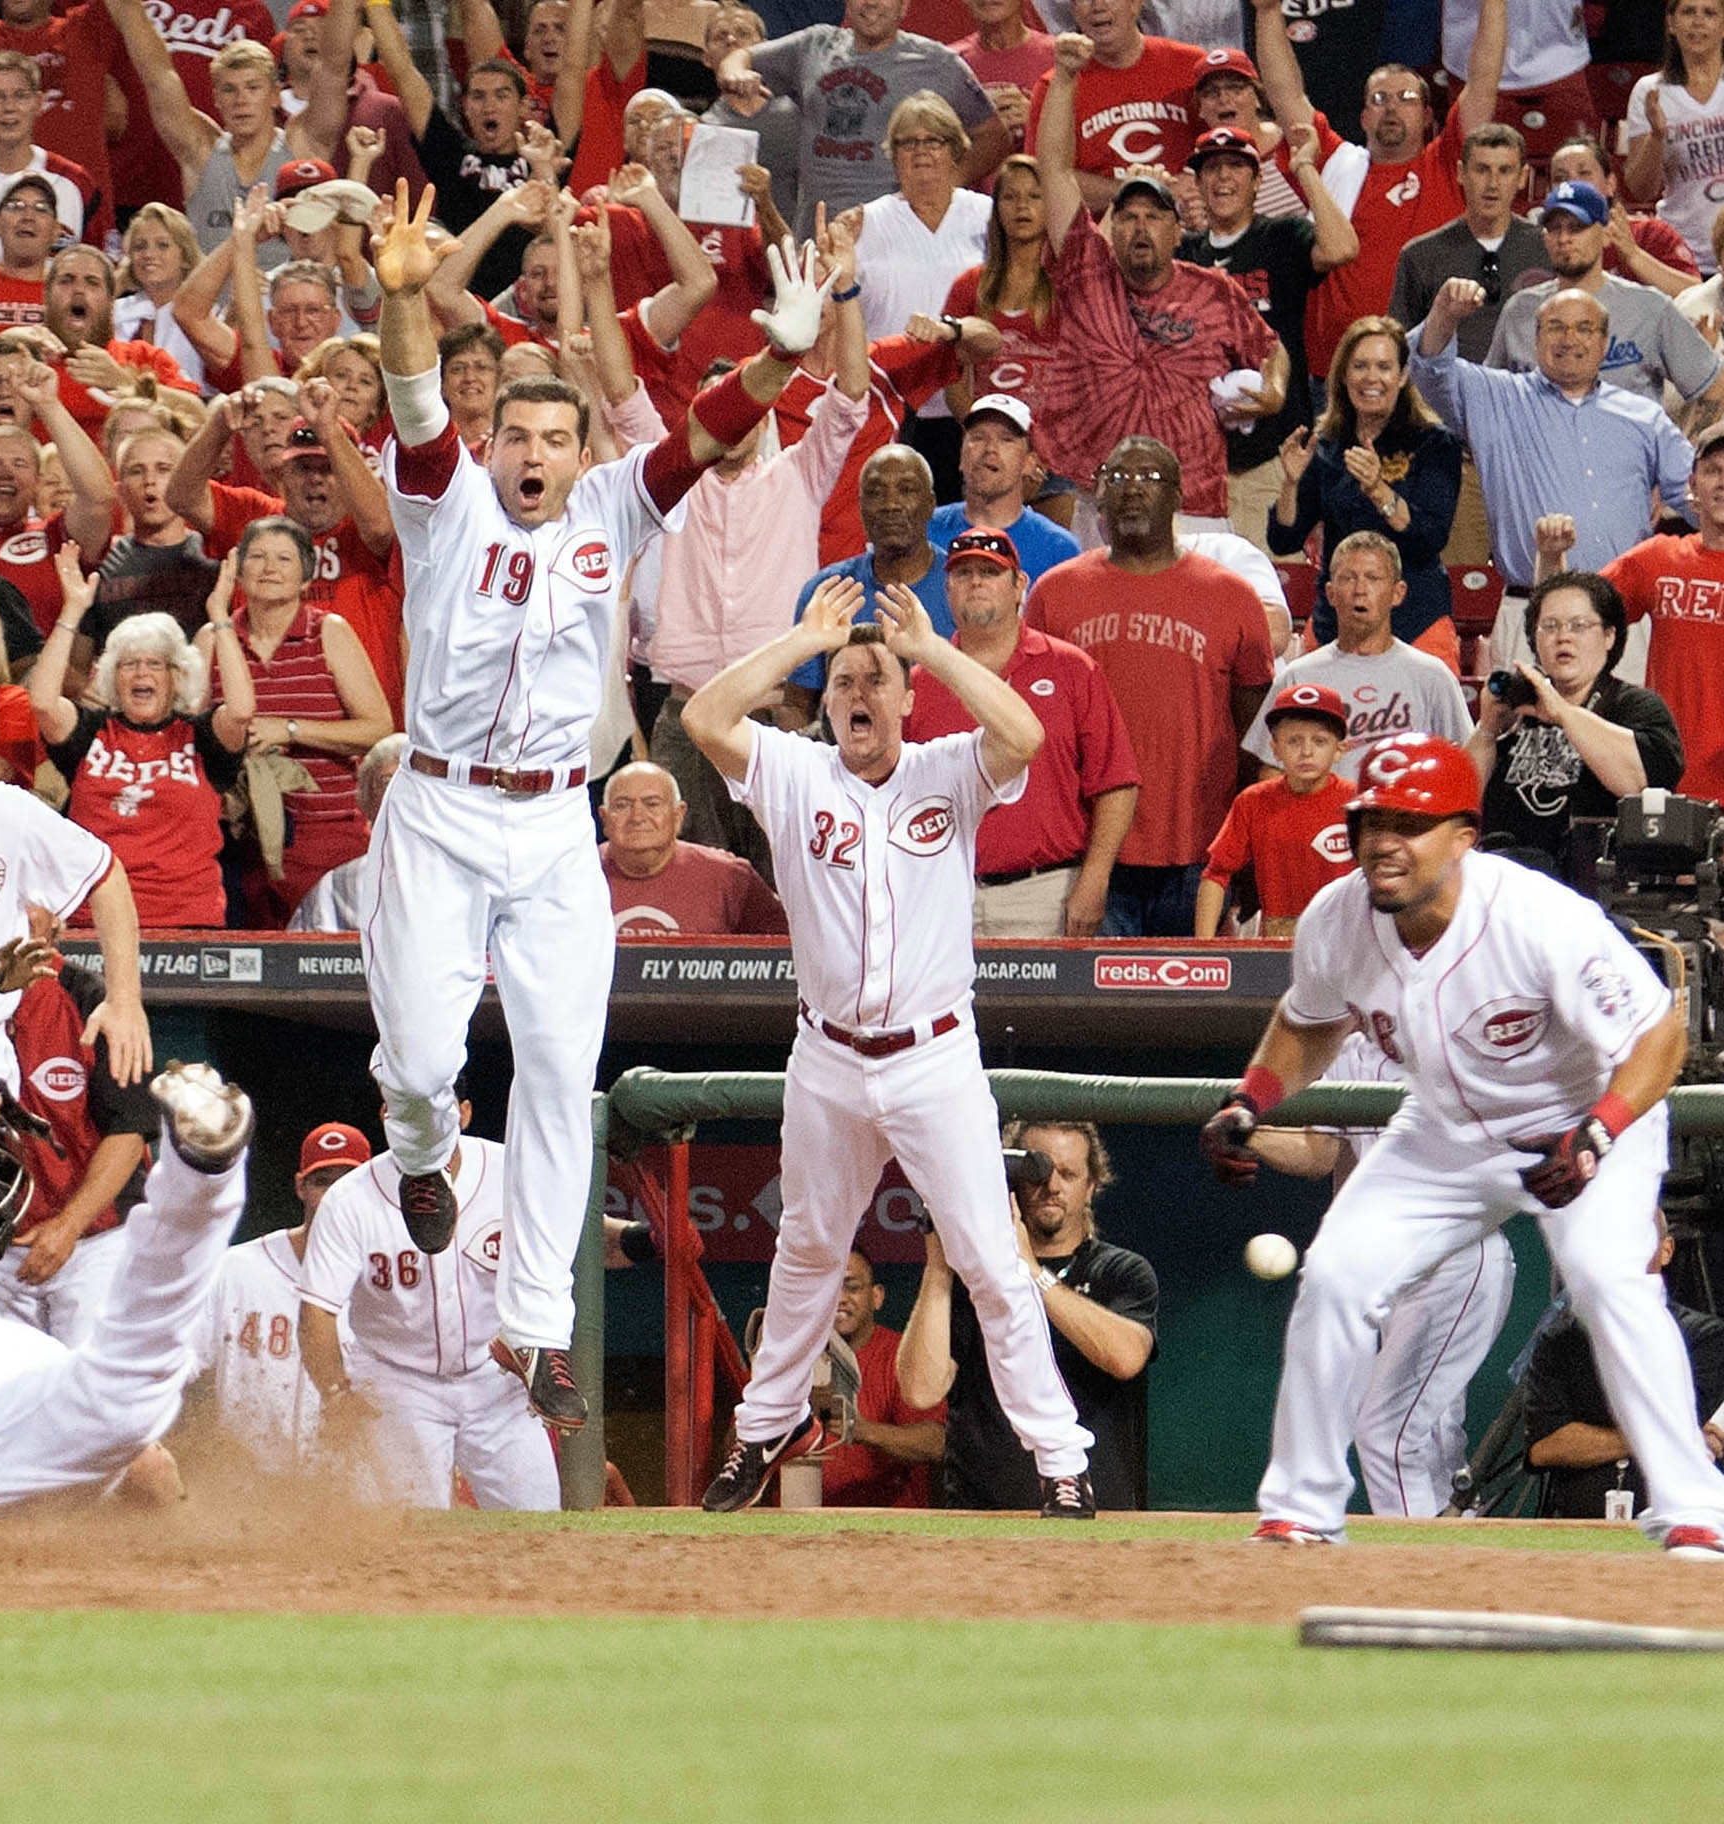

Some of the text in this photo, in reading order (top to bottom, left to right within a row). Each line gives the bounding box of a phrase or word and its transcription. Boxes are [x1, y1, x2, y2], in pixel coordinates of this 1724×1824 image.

[1081, 101, 1189, 139] CINCINNATI
[475, 541, 536, 606] 19
[1127, 612, 1207, 664] STATE
[809, 809, 863, 871] 32
[154, 955, 198, 974] FLAG
[298, 956, 364, 975] NEWERA
[641, 959, 797, 980] FLY YOUR OWN FL
[975, 962, 1057, 980] ACAP.COM
[368, 1250, 421, 1292] 36
[237, 1312, 290, 1361] 48
